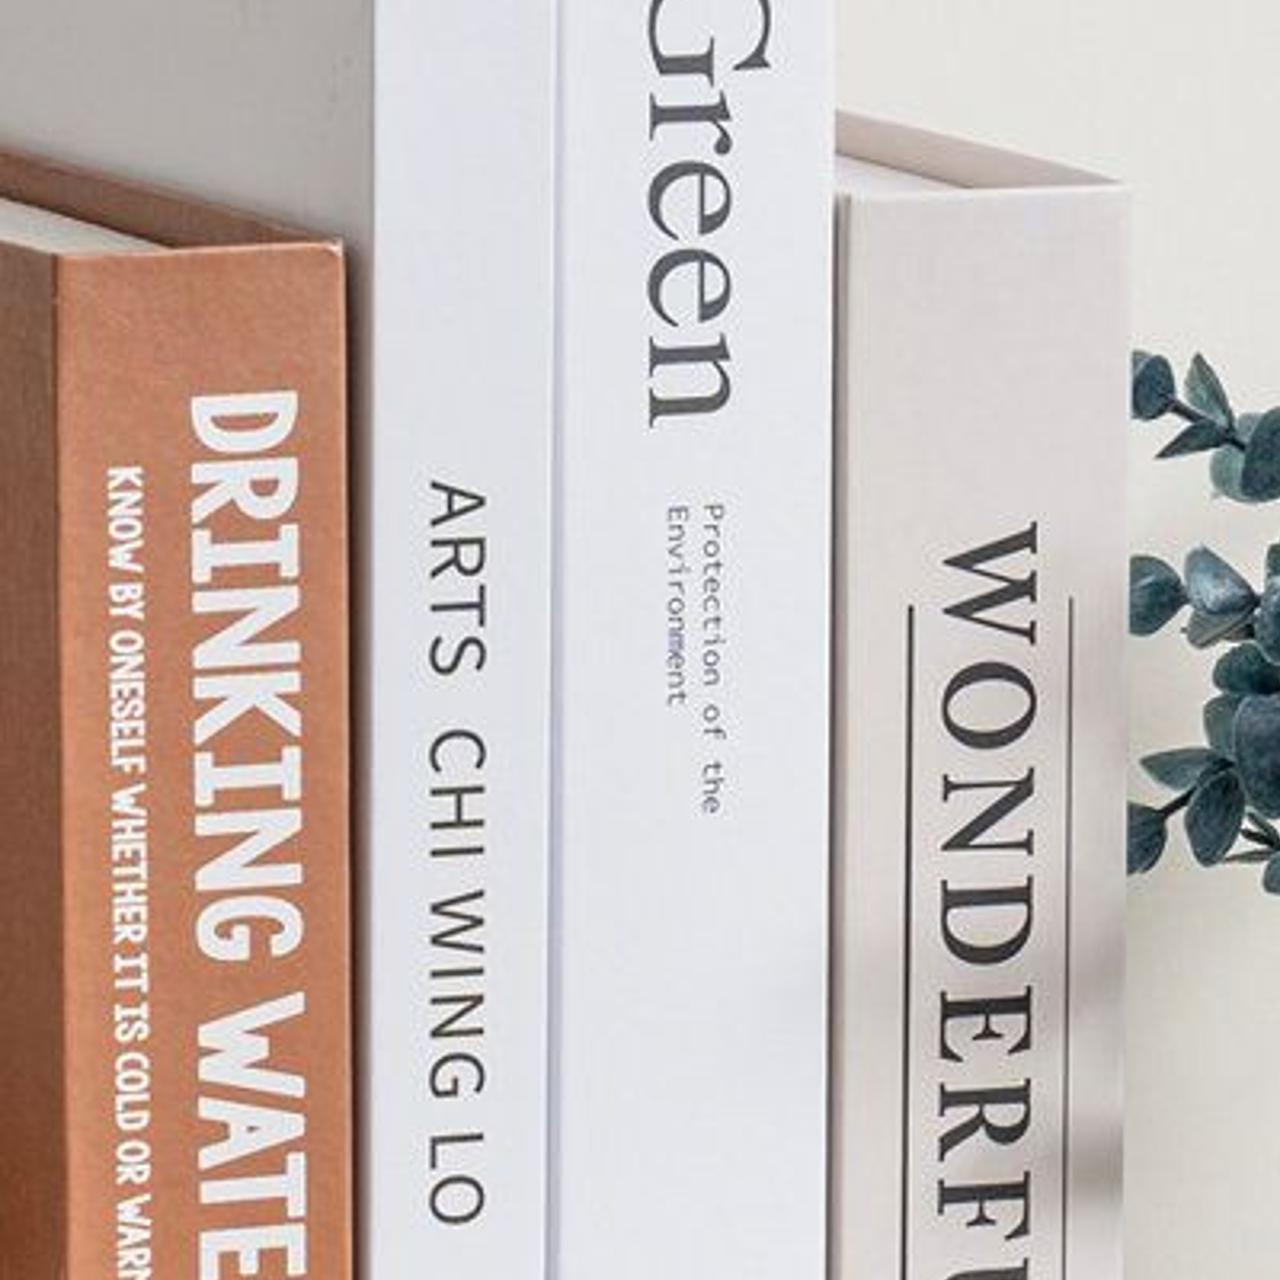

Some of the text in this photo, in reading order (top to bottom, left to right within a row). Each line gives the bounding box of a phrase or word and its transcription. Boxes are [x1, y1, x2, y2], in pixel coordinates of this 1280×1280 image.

[106, 466, 145, 573] KNOW
[108, 582, 146, 620] BY
[665, 504, 692, 708] Environment
[700, 502, 728, 815] Protection of the
[108, 629, 147, 774] ONESELF
[189, 389, 305, 962] DRINKING
[111, 782, 149, 945] WHETHER
[427, 478, 488, 1227] ARTS CHI WING LO
[112, 951, 150, 994] IT
[113, 1001, 152, 1044] IS
[114, 1050, 151, 1132] COLD
[115, 1139, 152, 1185] OR
